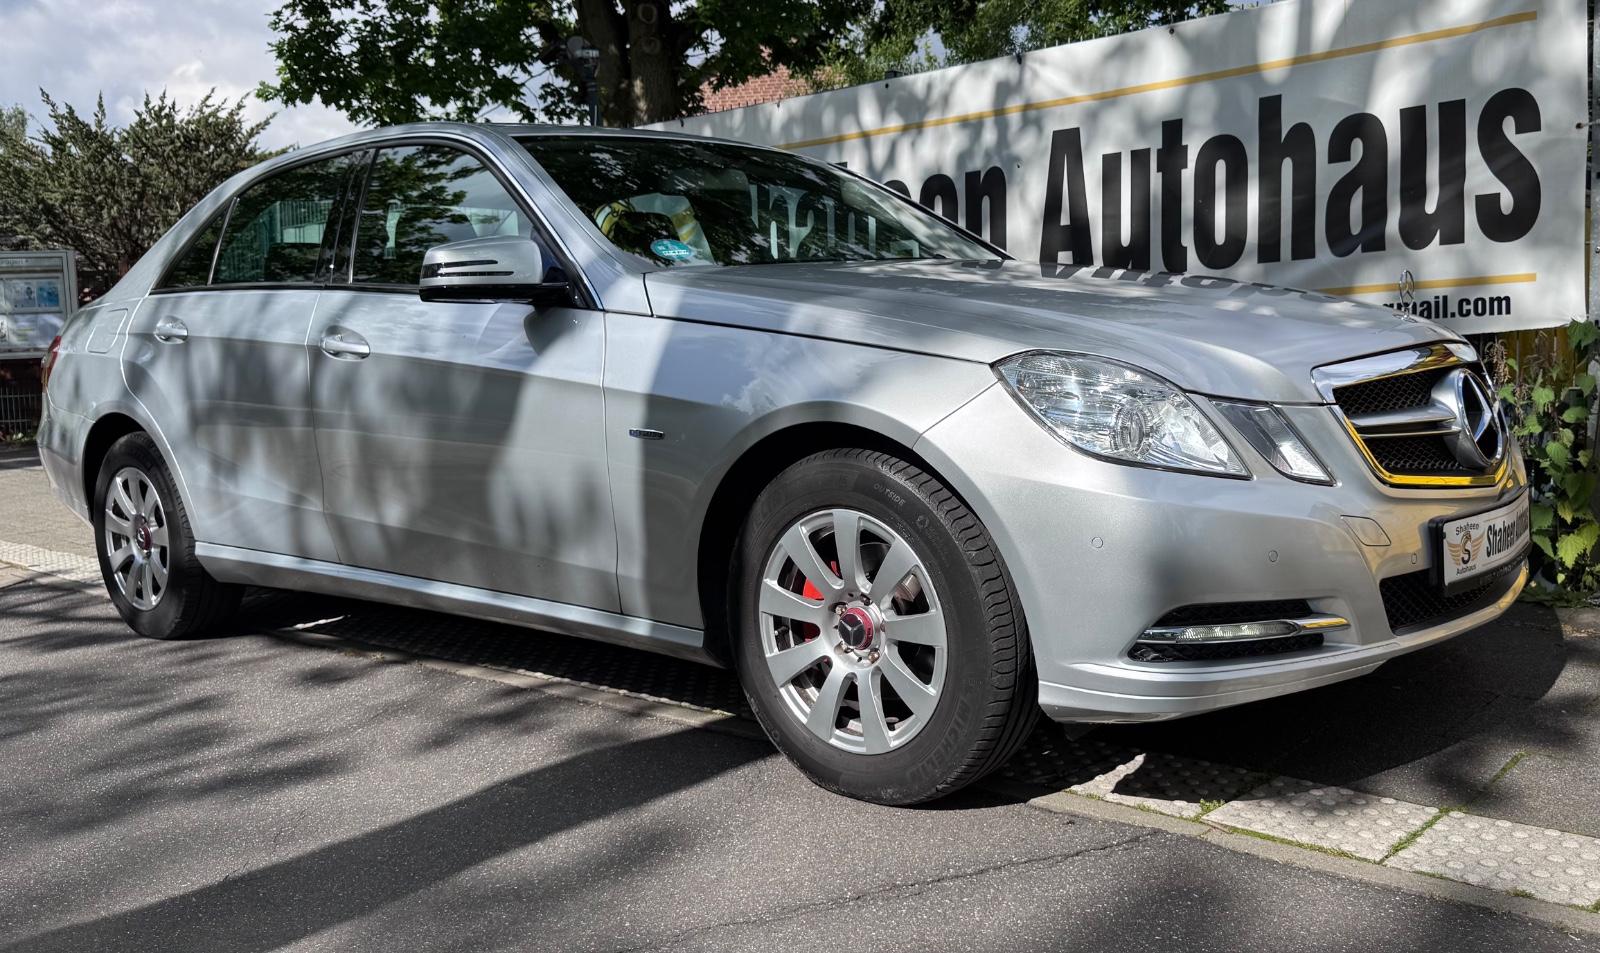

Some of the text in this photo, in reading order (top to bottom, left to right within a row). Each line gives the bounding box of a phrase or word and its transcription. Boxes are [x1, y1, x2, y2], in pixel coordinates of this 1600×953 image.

[1039, 87, 1542, 273] Autohaus
[1383, 295, 1511, 320] mail.com
[873, 482, 906, 506] OUTSIDE
[1455, 522, 1480, 536] Shaheen
